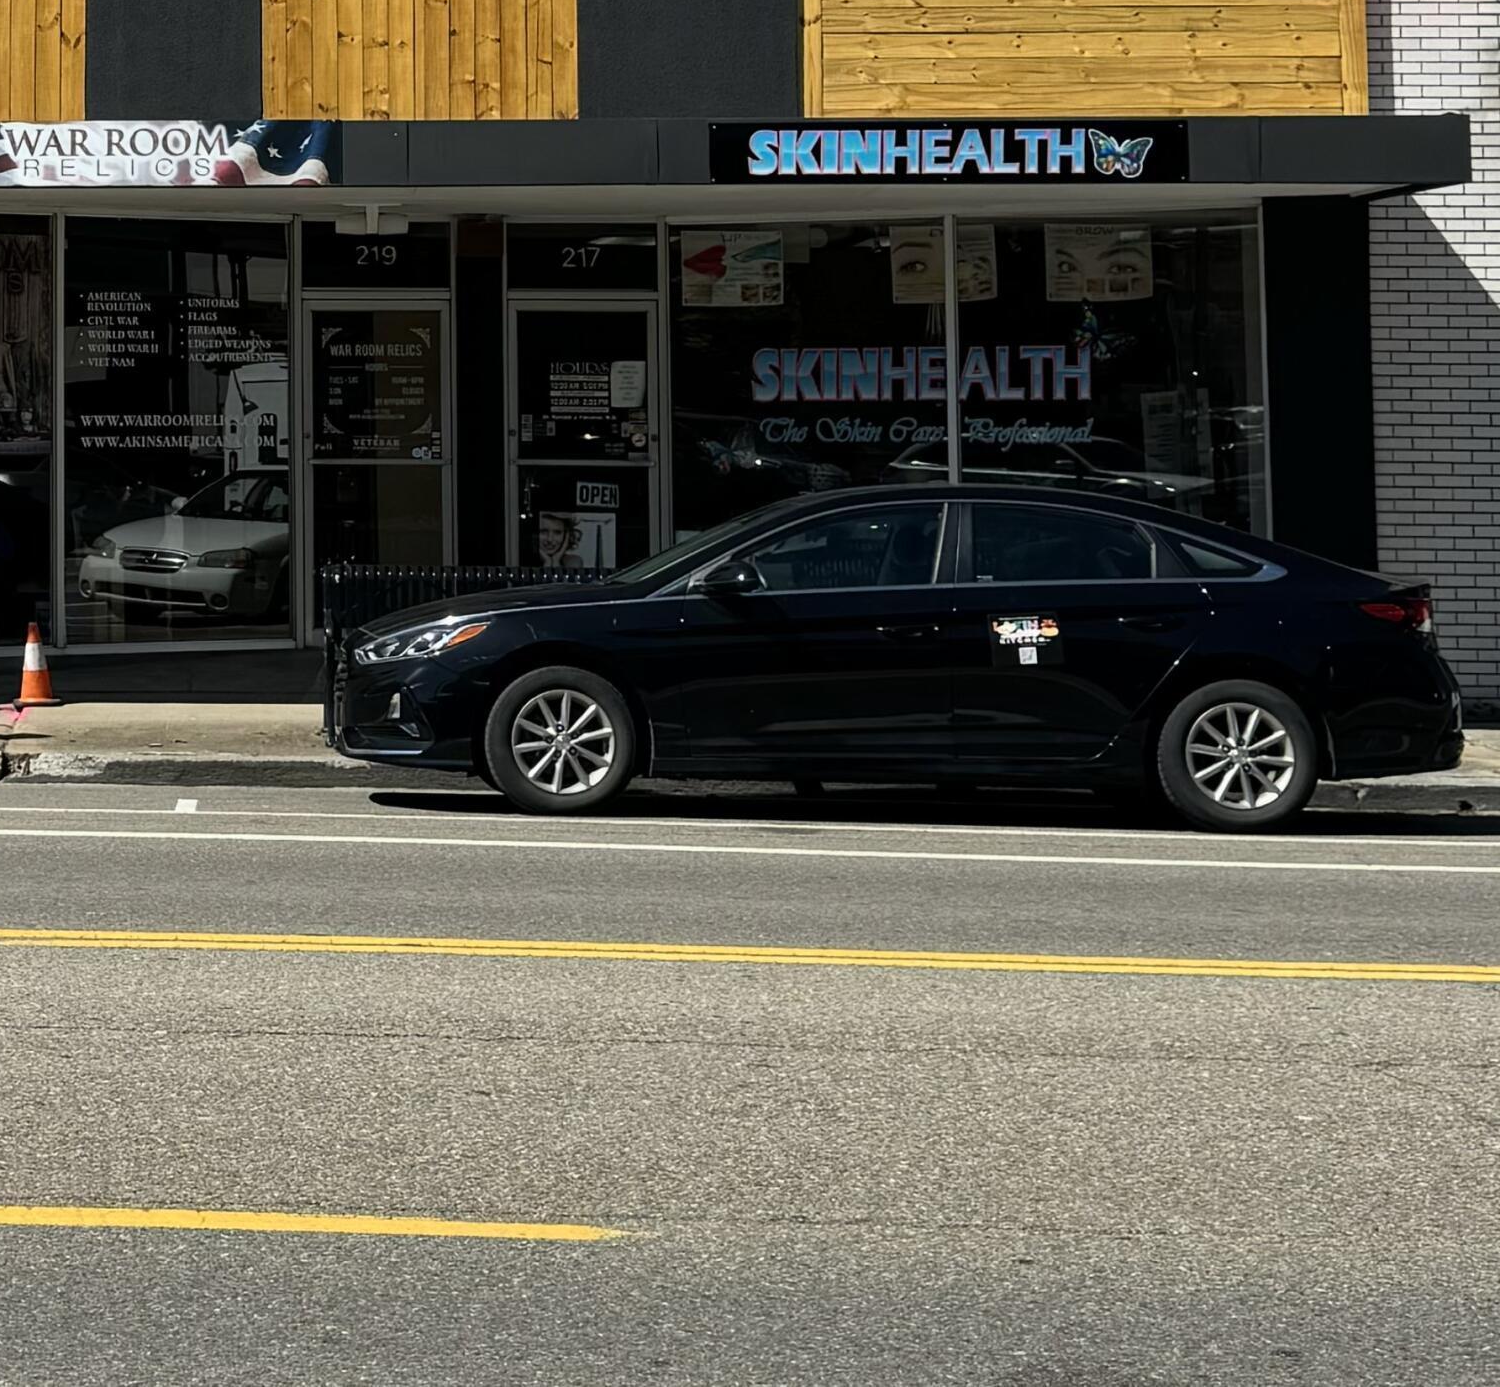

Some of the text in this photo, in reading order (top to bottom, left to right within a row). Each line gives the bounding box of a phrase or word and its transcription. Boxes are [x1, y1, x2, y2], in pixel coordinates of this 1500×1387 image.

[5, 124, 228, 157] WAR ROOM
[747, 127, 1087, 176] SKINHEALTH
[24, 158, 212, 178] RELICS
[356, 245, 398, 266] 219
[561, 246, 602, 269] 217
[87, 292, 142, 301] AMERICAN
[188, 298, 240, 308] UNIFORMS
[87, 302, 152, 312] REVOLUTION
[87, 316, 140, 326] CIVIL WAR
[188, 311, 218, 321] FLAGS
[88, 330, 155, 340] WORLD WAR I
[188, 325, 238, 335] FIREARMS
[88, 343, 159, 354] WORLD WAR II
[188, 339, 271, 349] EDGED WEAPONS
[329, 343, 422, 357] WAR ROOM RELICS
[189, 352, 277, 363] ACCOUTREMENT
[549, 361, 610, 374] HOURS
[750, 344, 1093, 403] SKINHEALTH
[80, 414, 275, 427] WWW.WARROOMRELIOM
[759, 416, 807, 444] The
[815, 416, 881, 444] Skin
[964, 416, 1094, 453] Professional
[80, 435, 275, 448] WWW.AKINSAMERICAOM
[580, 485, 617, 505] OPEN
